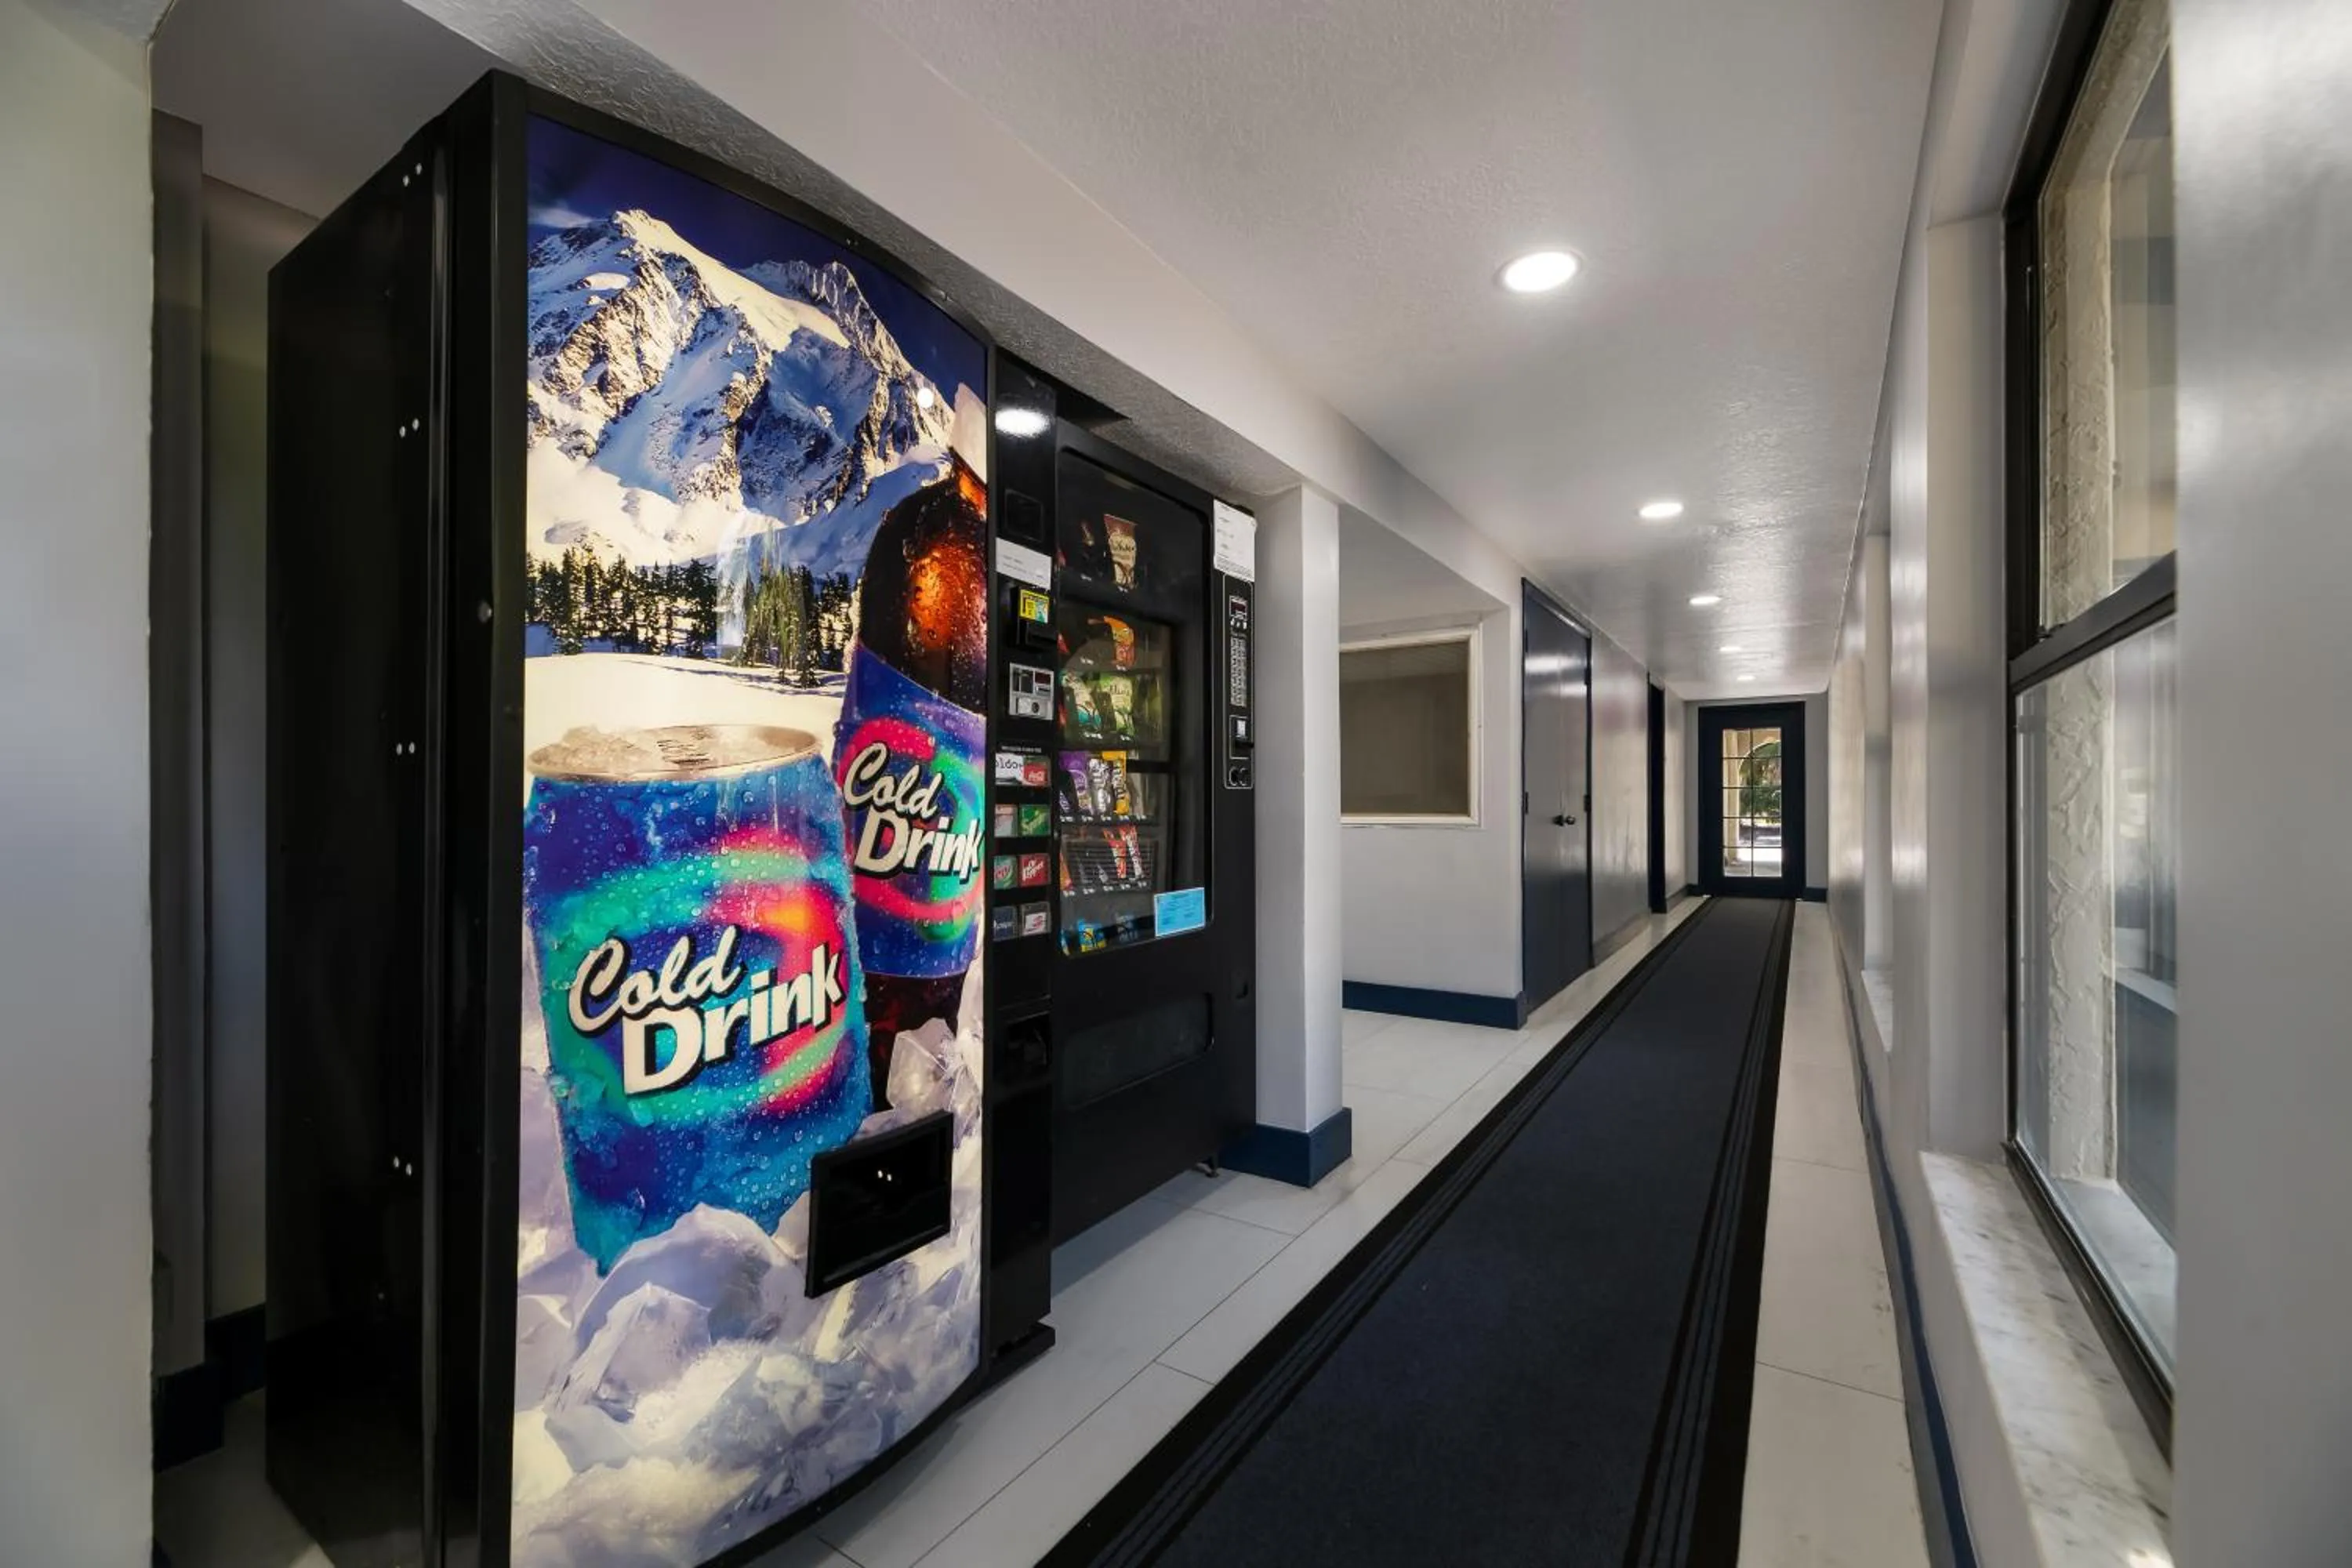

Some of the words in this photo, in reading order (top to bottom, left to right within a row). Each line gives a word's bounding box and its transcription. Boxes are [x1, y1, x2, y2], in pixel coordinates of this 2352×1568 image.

[844, 742, 943, 820] Cold
[854, 805, 984, 880] Drink
[568, 925, 743, 1033] Cold
[622, 943, 844, 1094] Drink
